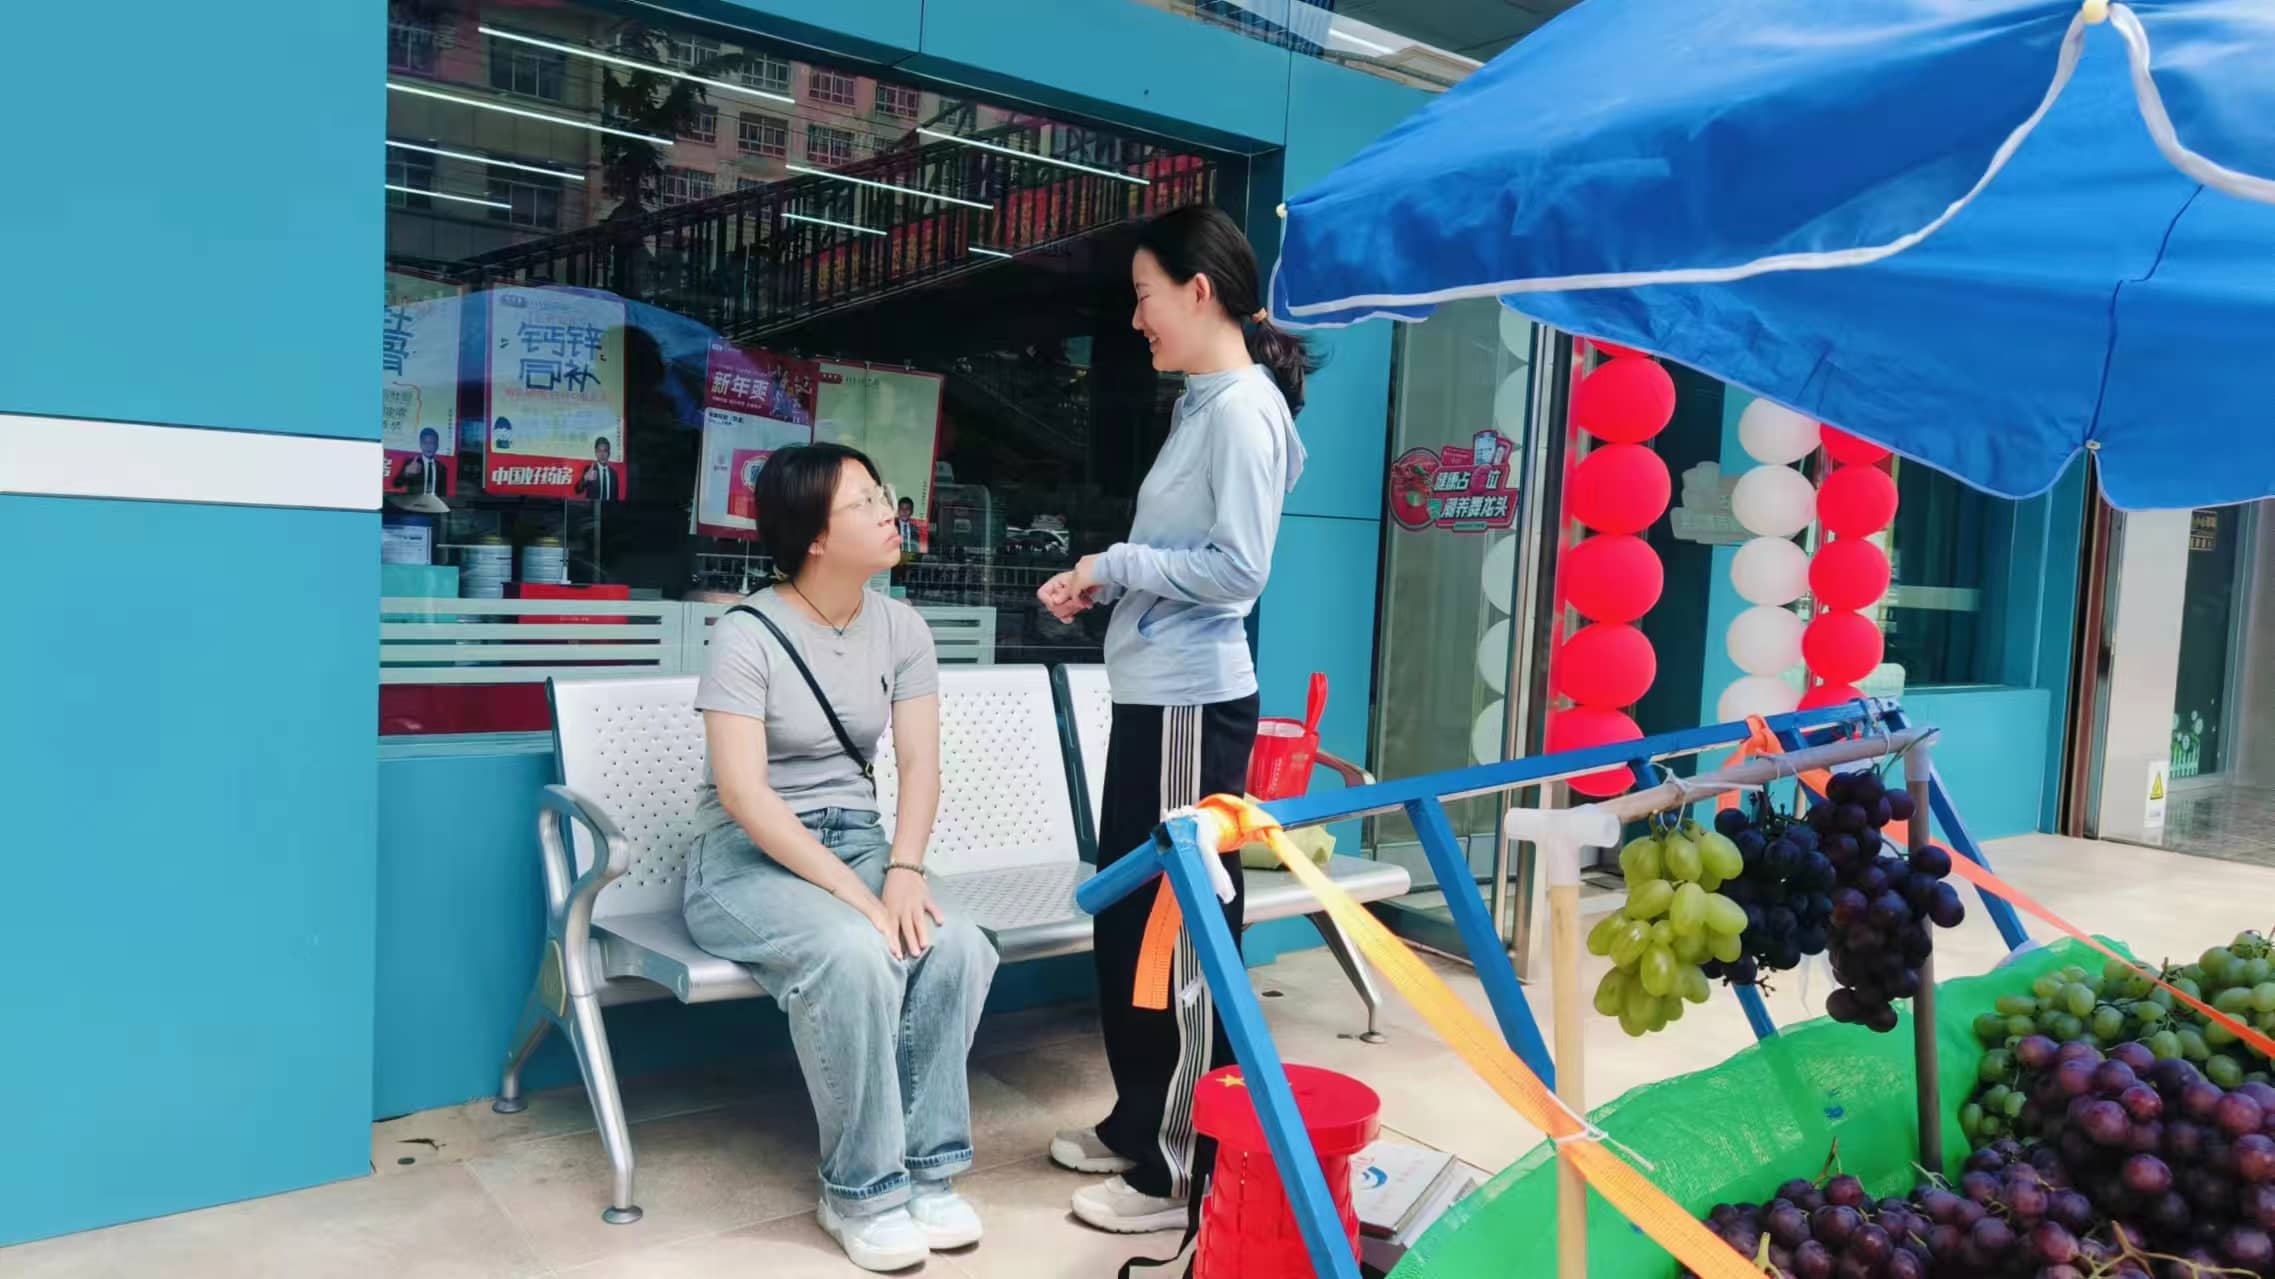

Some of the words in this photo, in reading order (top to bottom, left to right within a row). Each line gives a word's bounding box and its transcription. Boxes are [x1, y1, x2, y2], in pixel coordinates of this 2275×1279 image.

[517, 322, 604, 360] 钙锌
[519, 358, 602, 393] 同补
[711, 371, 770, 401] 新年爽
[491, 466, 574, 487] 中国好药房
